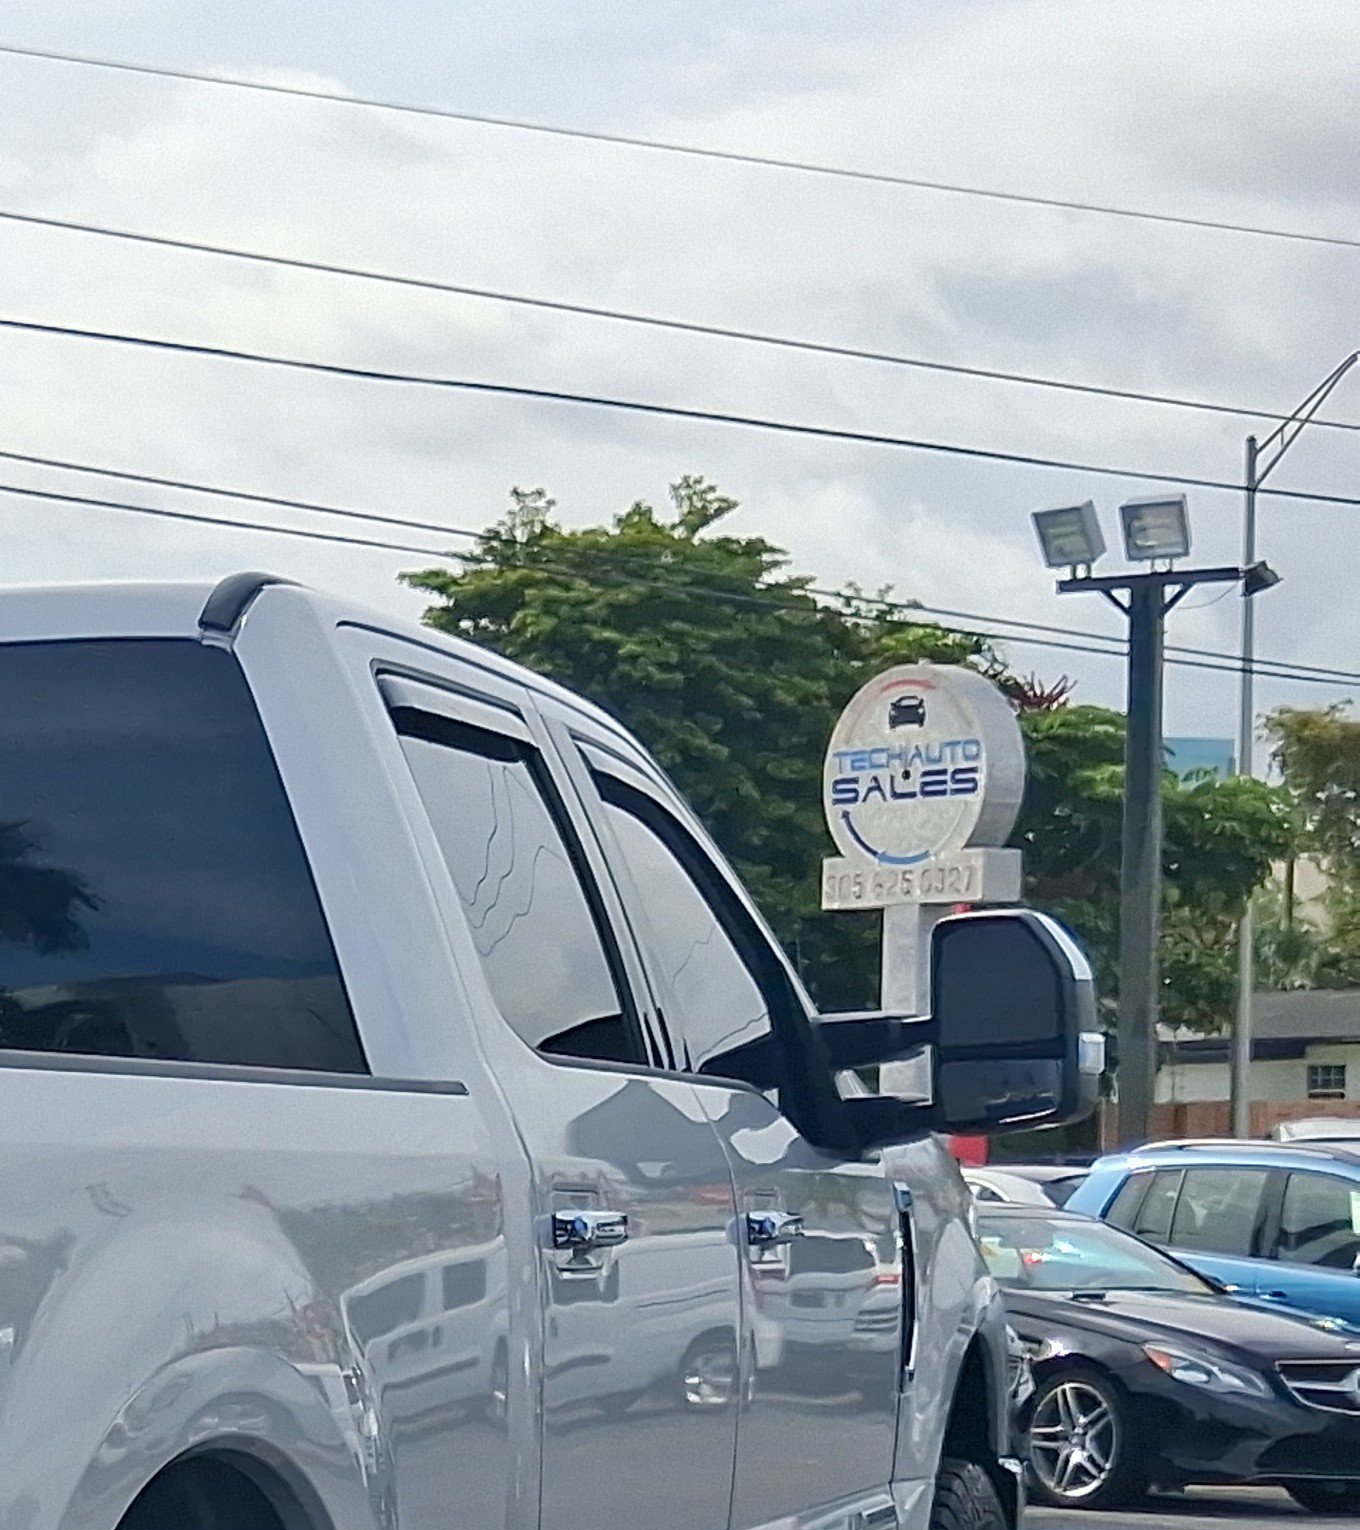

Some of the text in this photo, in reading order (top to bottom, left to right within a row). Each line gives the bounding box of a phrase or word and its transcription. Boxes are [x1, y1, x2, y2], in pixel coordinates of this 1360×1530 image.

[832, 739, 981, 774] TECH AUTO
[832, 767, 979, 806] SALES
